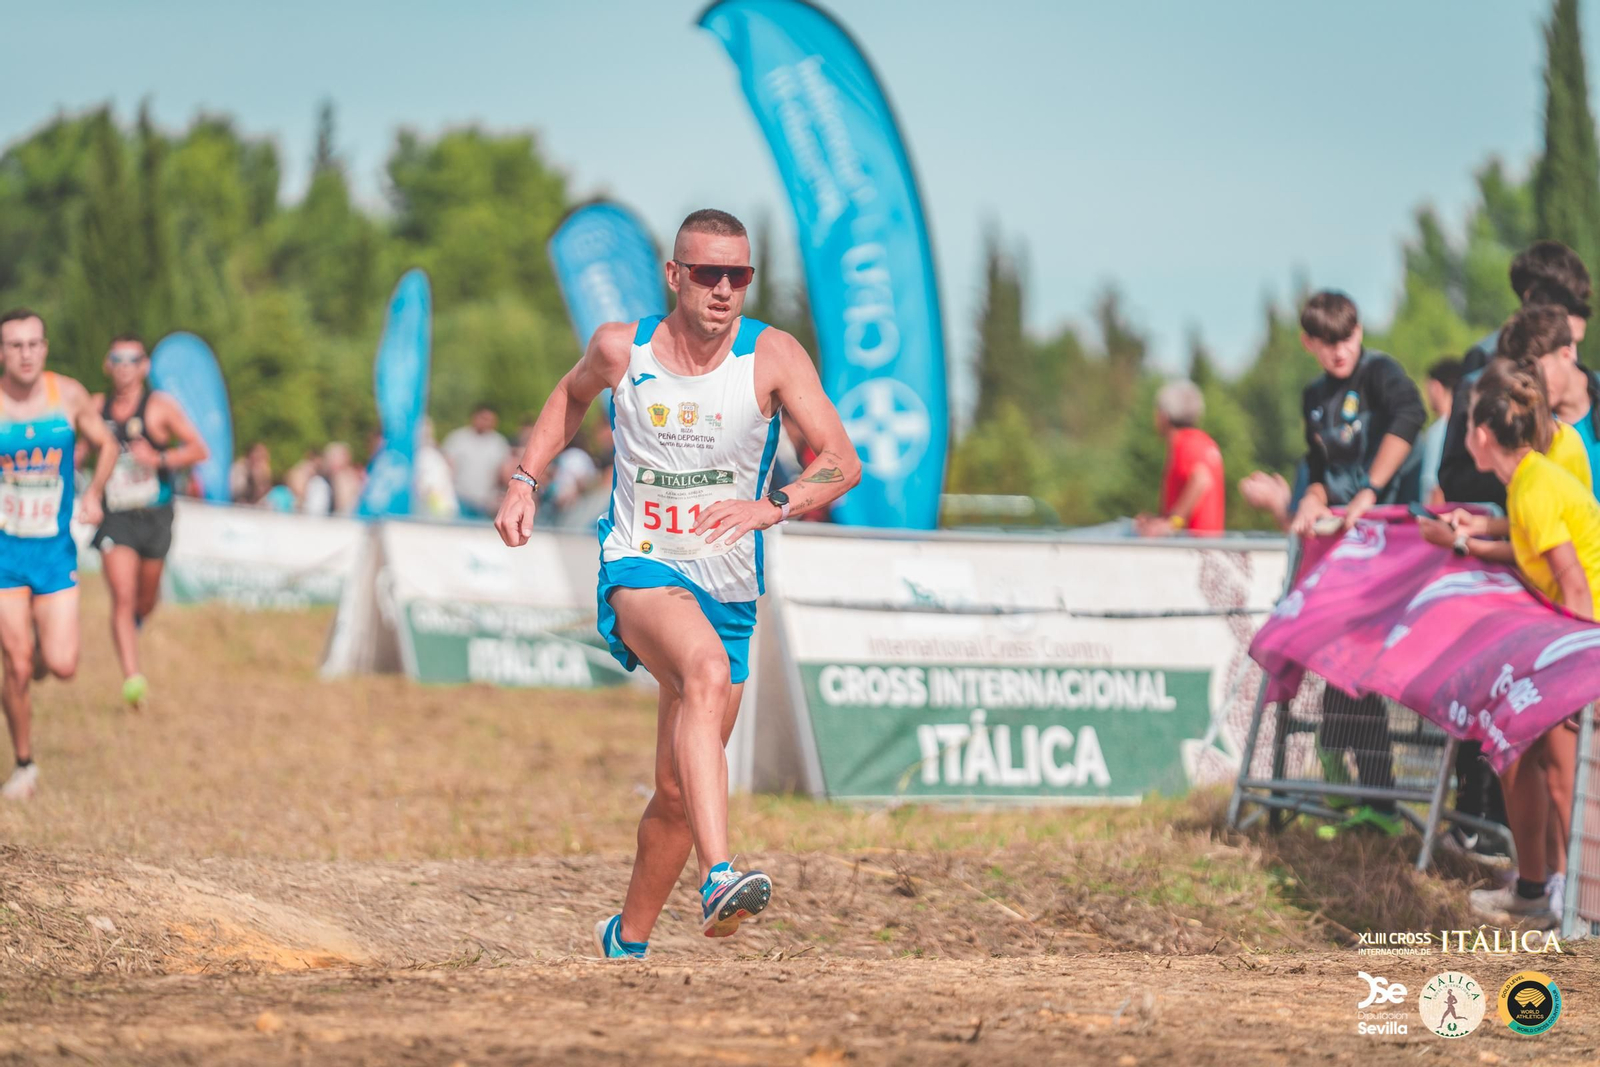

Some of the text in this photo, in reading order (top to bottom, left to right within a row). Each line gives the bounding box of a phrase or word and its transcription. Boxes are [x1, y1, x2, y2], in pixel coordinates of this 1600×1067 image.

[658, 432, 715, 443] PEÑA DEPORTIVA
[661, 474, 709, 486] ITÁLICA
[643, 501, 722, 534] 511
[819, 665, 1176, 712] CROSS INTERNACIONAL
[917, 709, 1112, 788] ITÁLICA
